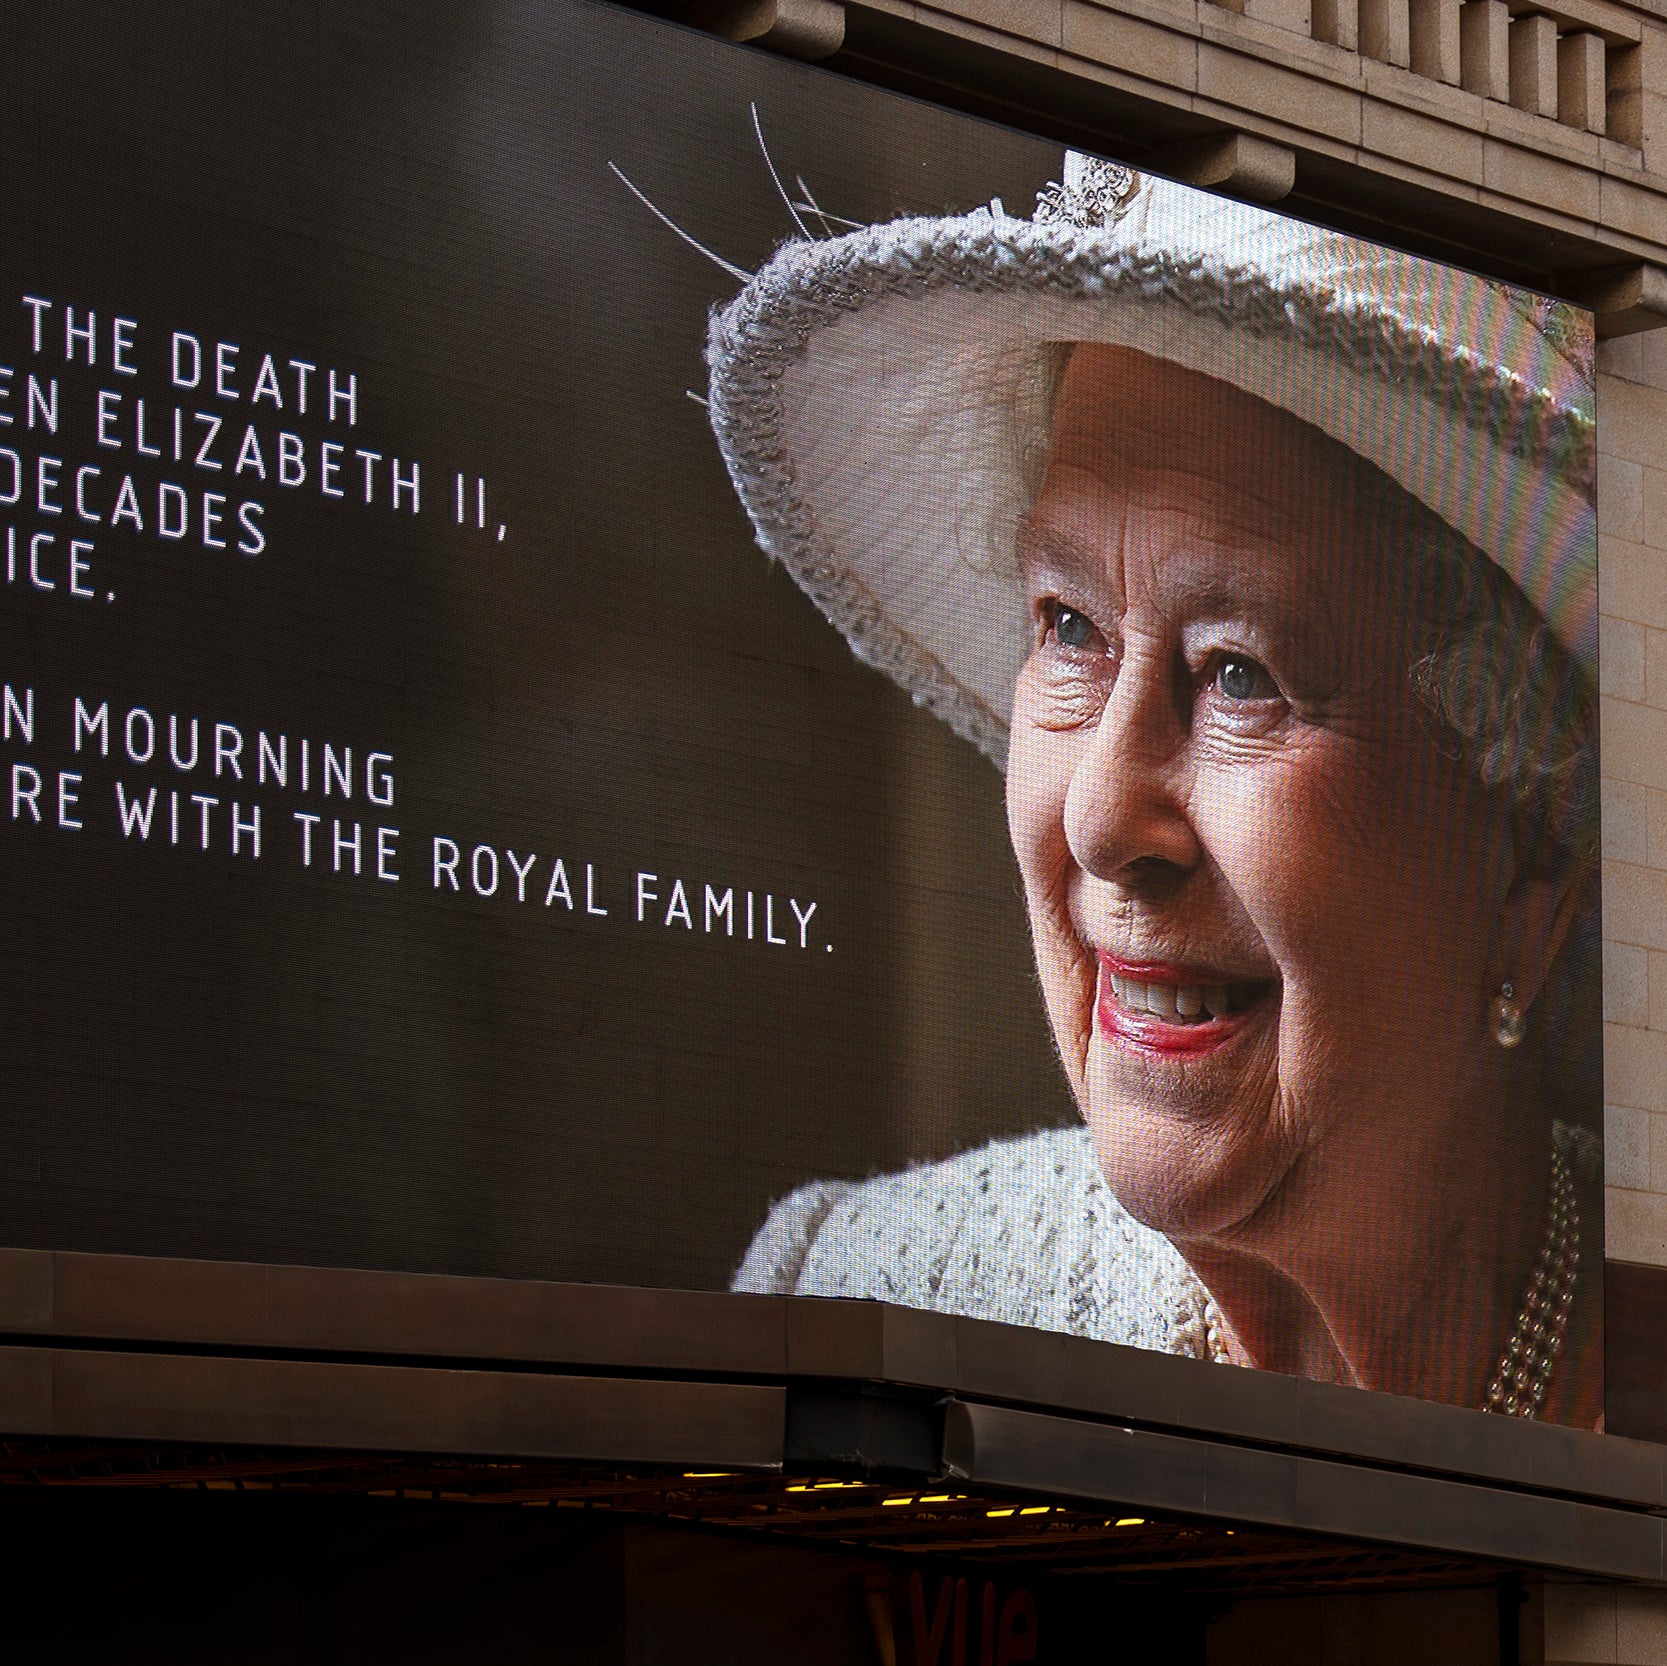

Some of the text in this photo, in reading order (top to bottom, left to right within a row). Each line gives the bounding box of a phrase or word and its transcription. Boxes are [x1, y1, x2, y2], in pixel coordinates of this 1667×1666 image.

[22, 295, 358, 427] THE DEATH
[0, 448, 267, 556] DECADES
[97, 390, 422, 516] ELIZABETH
[455, 473, 508, 543] II,
[7, 524, 117, 603] ICE.
[74, 697, 396, 807] MOURNING
[11, 763, 834, 953] RE WITH THE ROYAL FAMILY.
